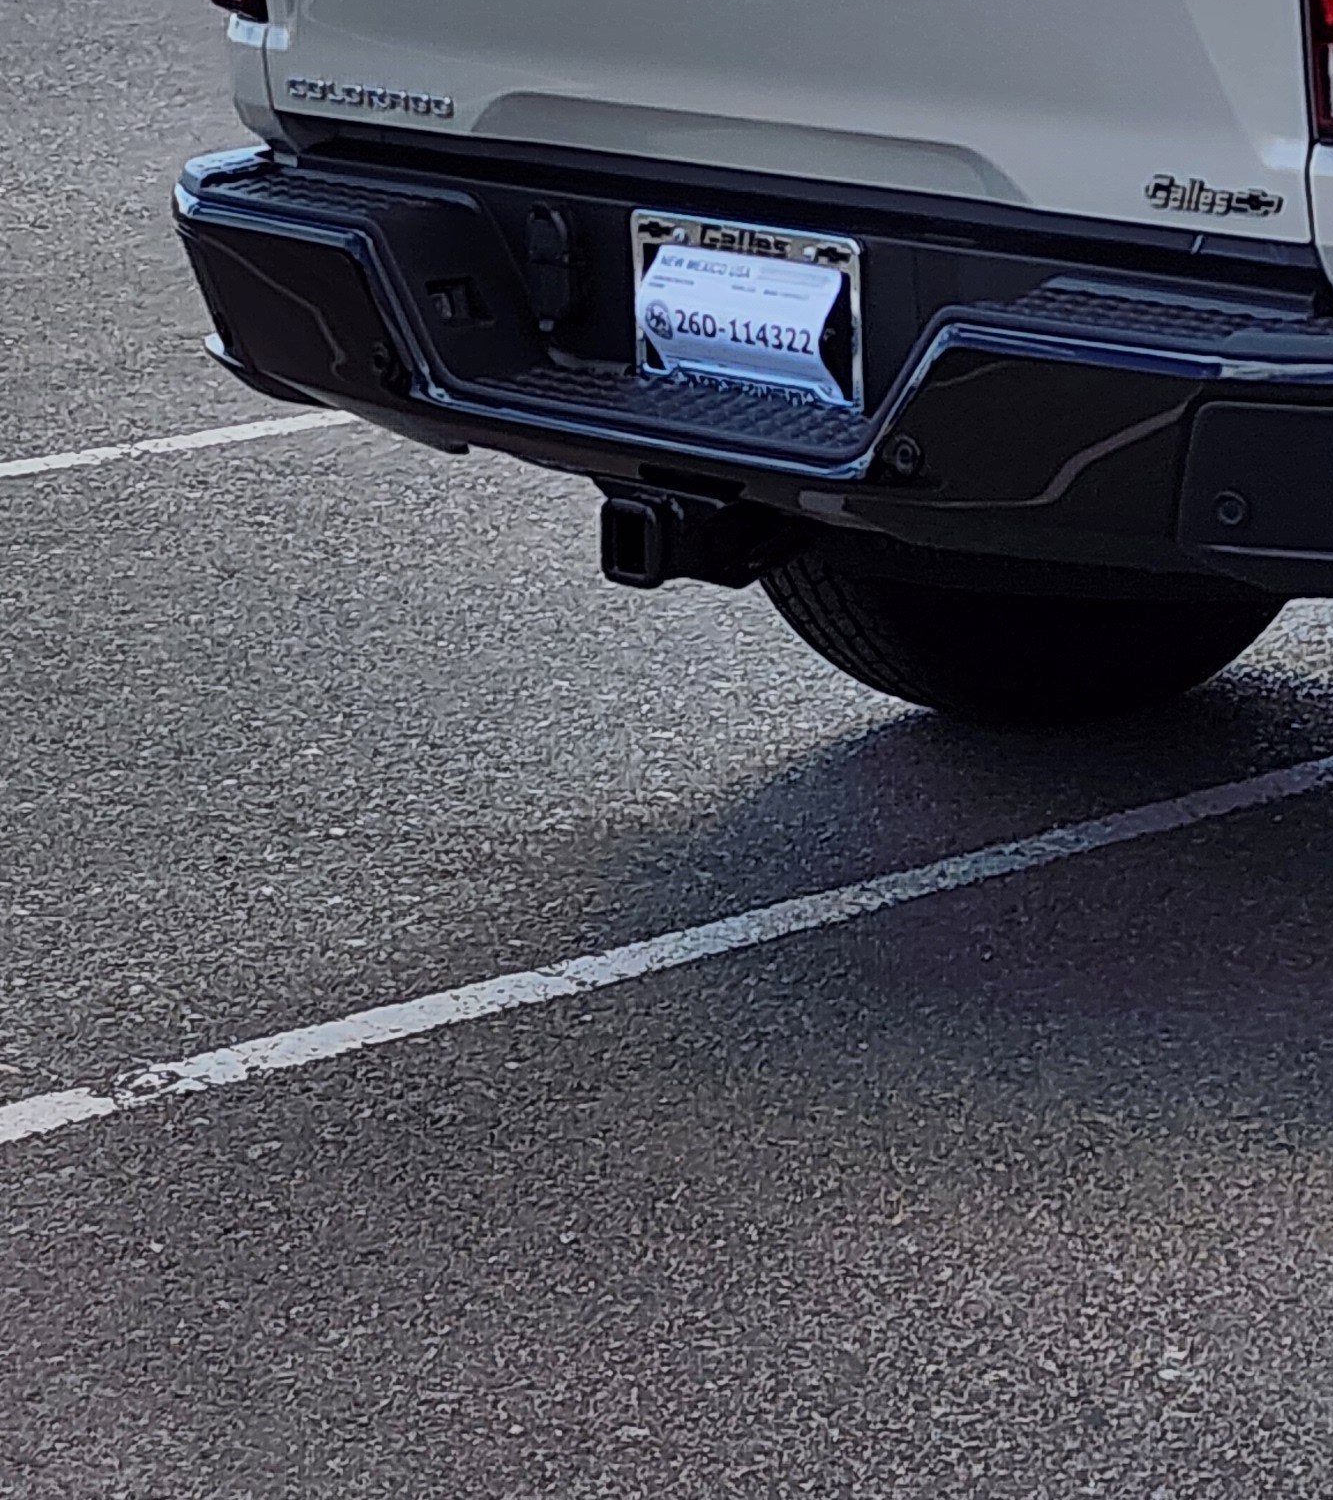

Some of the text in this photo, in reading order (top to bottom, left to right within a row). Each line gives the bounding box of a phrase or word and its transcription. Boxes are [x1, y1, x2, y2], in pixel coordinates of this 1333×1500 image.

[286, 76, 455, 119] COLORADO
[1145, 174, 1232, 216] Galles
[699, 223, 793, 258] Galles
